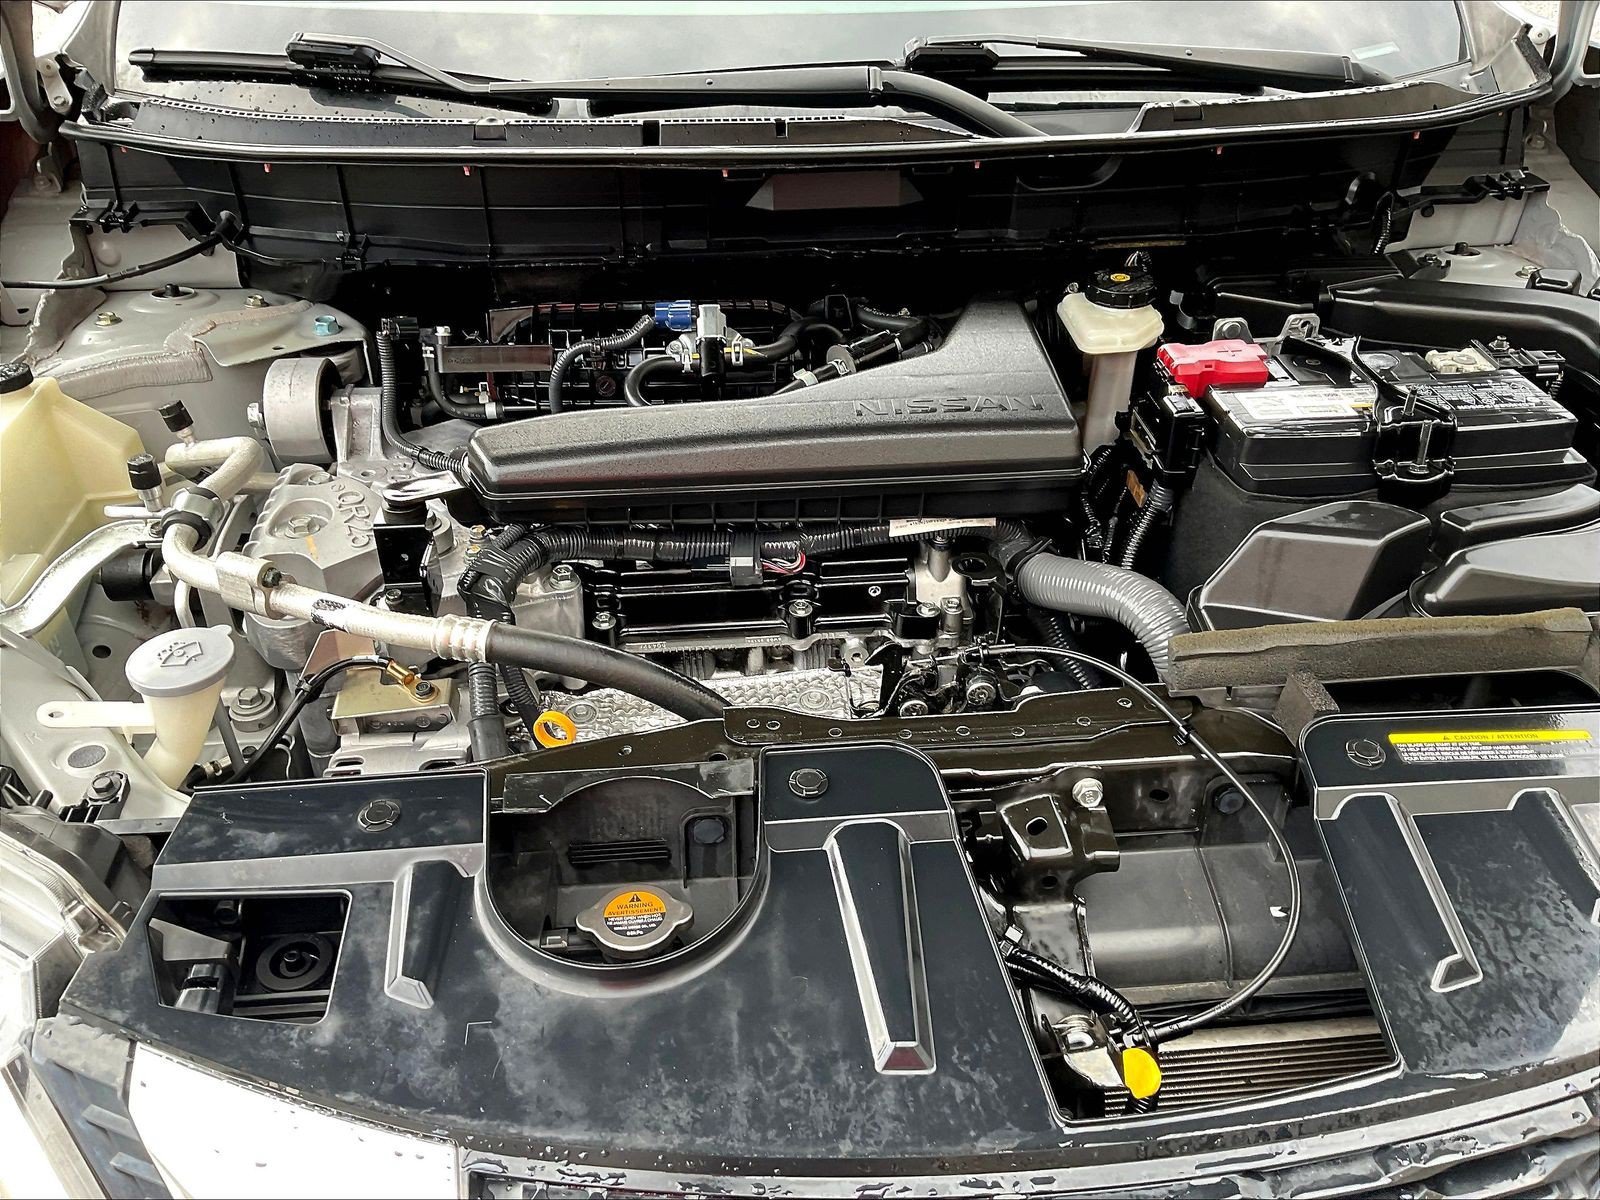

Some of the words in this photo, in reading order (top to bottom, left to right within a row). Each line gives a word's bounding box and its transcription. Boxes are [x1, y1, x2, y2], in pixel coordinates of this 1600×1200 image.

[853, 394, 1045, 417] NISSAN
[337, 489, 374, 548] QR25
[608, 908, 661, 916] AVERTISSEMENT
[617, 902, 653, 910] WARNING
